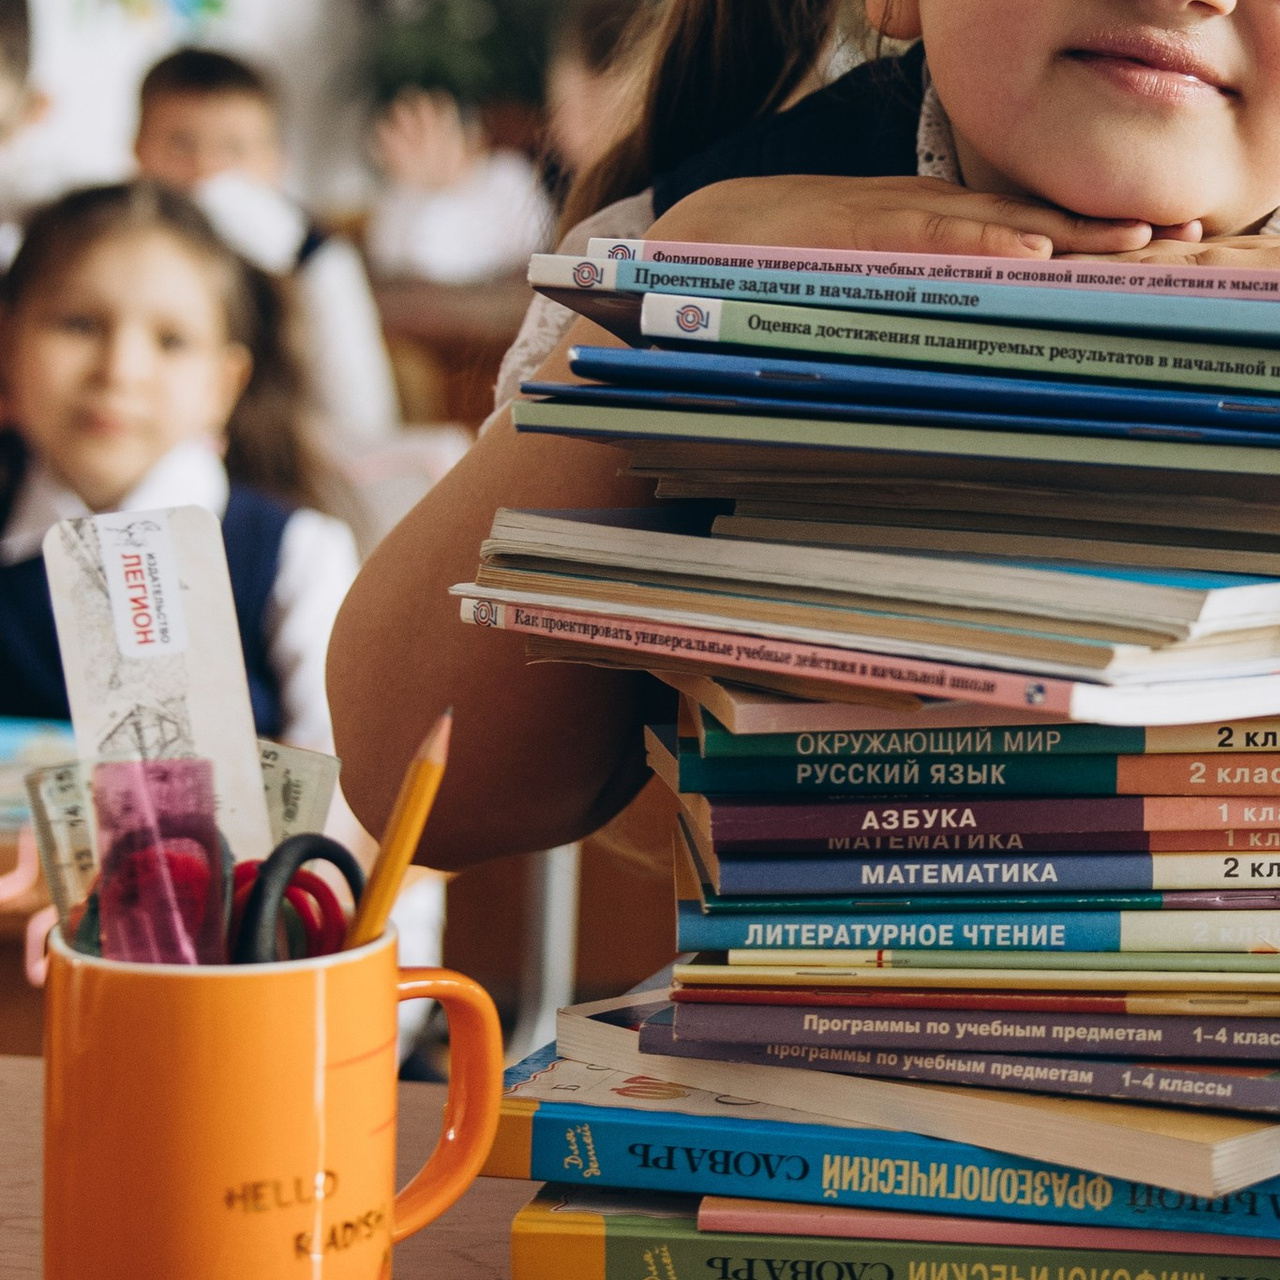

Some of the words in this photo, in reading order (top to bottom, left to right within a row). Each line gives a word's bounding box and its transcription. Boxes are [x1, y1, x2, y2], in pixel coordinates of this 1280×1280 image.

[634, 267, 735, 292] Проектные
[738, 277, 801, 297] задачи
[804, 283, 816, 296] в
[819, 283, 916, 304] начальной
[920, 290, 980, 308] школе
[652, 250, 755, 269] Формирование
[757, 258, 863, 274] универсальных
[865, 262, 926, 277] учебных
[928, 264, 993, 281] действий
[995, 270, 1004, 280] в
[1007, 268, 1073, 284] основной
[1075, 273, 1126, 286] школе:
[1128, 276, 1145, 287] от
[1147, 274, 1215, 290] действия
[1217, 280, 1227, 290] к
[1229, 280, 1279, 292] мысли
[747, 314, 812, 336] Оценка
[814, 322, 921, 347] достижения
[923, 332, 1045, 357] планируемых
[1048, 344, 1155, 368] результатов
[1157, 355, 1169, 368] в
[1172, 355, 1267, 377] начальной
[513, 608, 539, 627] Как
[541, 615, 633, 641] проектировать
[634, 630, 734, 658] универсальные
[736, 642, 792, 664] учебные
[793, 651, 858, 675] действия
[859, 663, 867, 675] в
[870, 662, 947, 687] начальной
[949, 677, 996, 694] школе
[796, 728, 993, 756] ОКРУЖАЮЩИЙ
[1003, 730, 1062, 753] МИР
[1217, 726, 1234, 748] 2
[796, 759, 920, 786] РУССКИЙ
[930, 764, 1007, 786] ЯЗЫК
[1189, 761, 1207, 784] 2
[861, 808, 977, 831] АЗБУКА
[1218, 803, 1229, 822] 1
[1224, 830, 1235, 846] 1
[860, 862, 1058, 885] МАТЕМАТИКА
[1223, 857, 1240, 878] 2
[744, 924, 954, 947] ЛИТЕРАТУРНОЕ
[963, 923, 1066, 947] ЧТЕНИЕ
[803, 1013, 921, 1035] Программы
[926, 1020, 950, 1035] по
[955, 1019, 1047, 1039] учебным
[1051, 1024, 1163, 1042] предметам
[876, 1051, 899, 1066] по
[902, 1052, 986, 1074] учебным
[989, 1060, 1094, 1084] предметам
[1158, 1076, 1233, 1098] классы
[628, 1142, 810, 1182] СЛОВАРЬ
[821, 1154, 1113, 1211] ФРАЗЕОЛОГИЧЕСКИЙ
